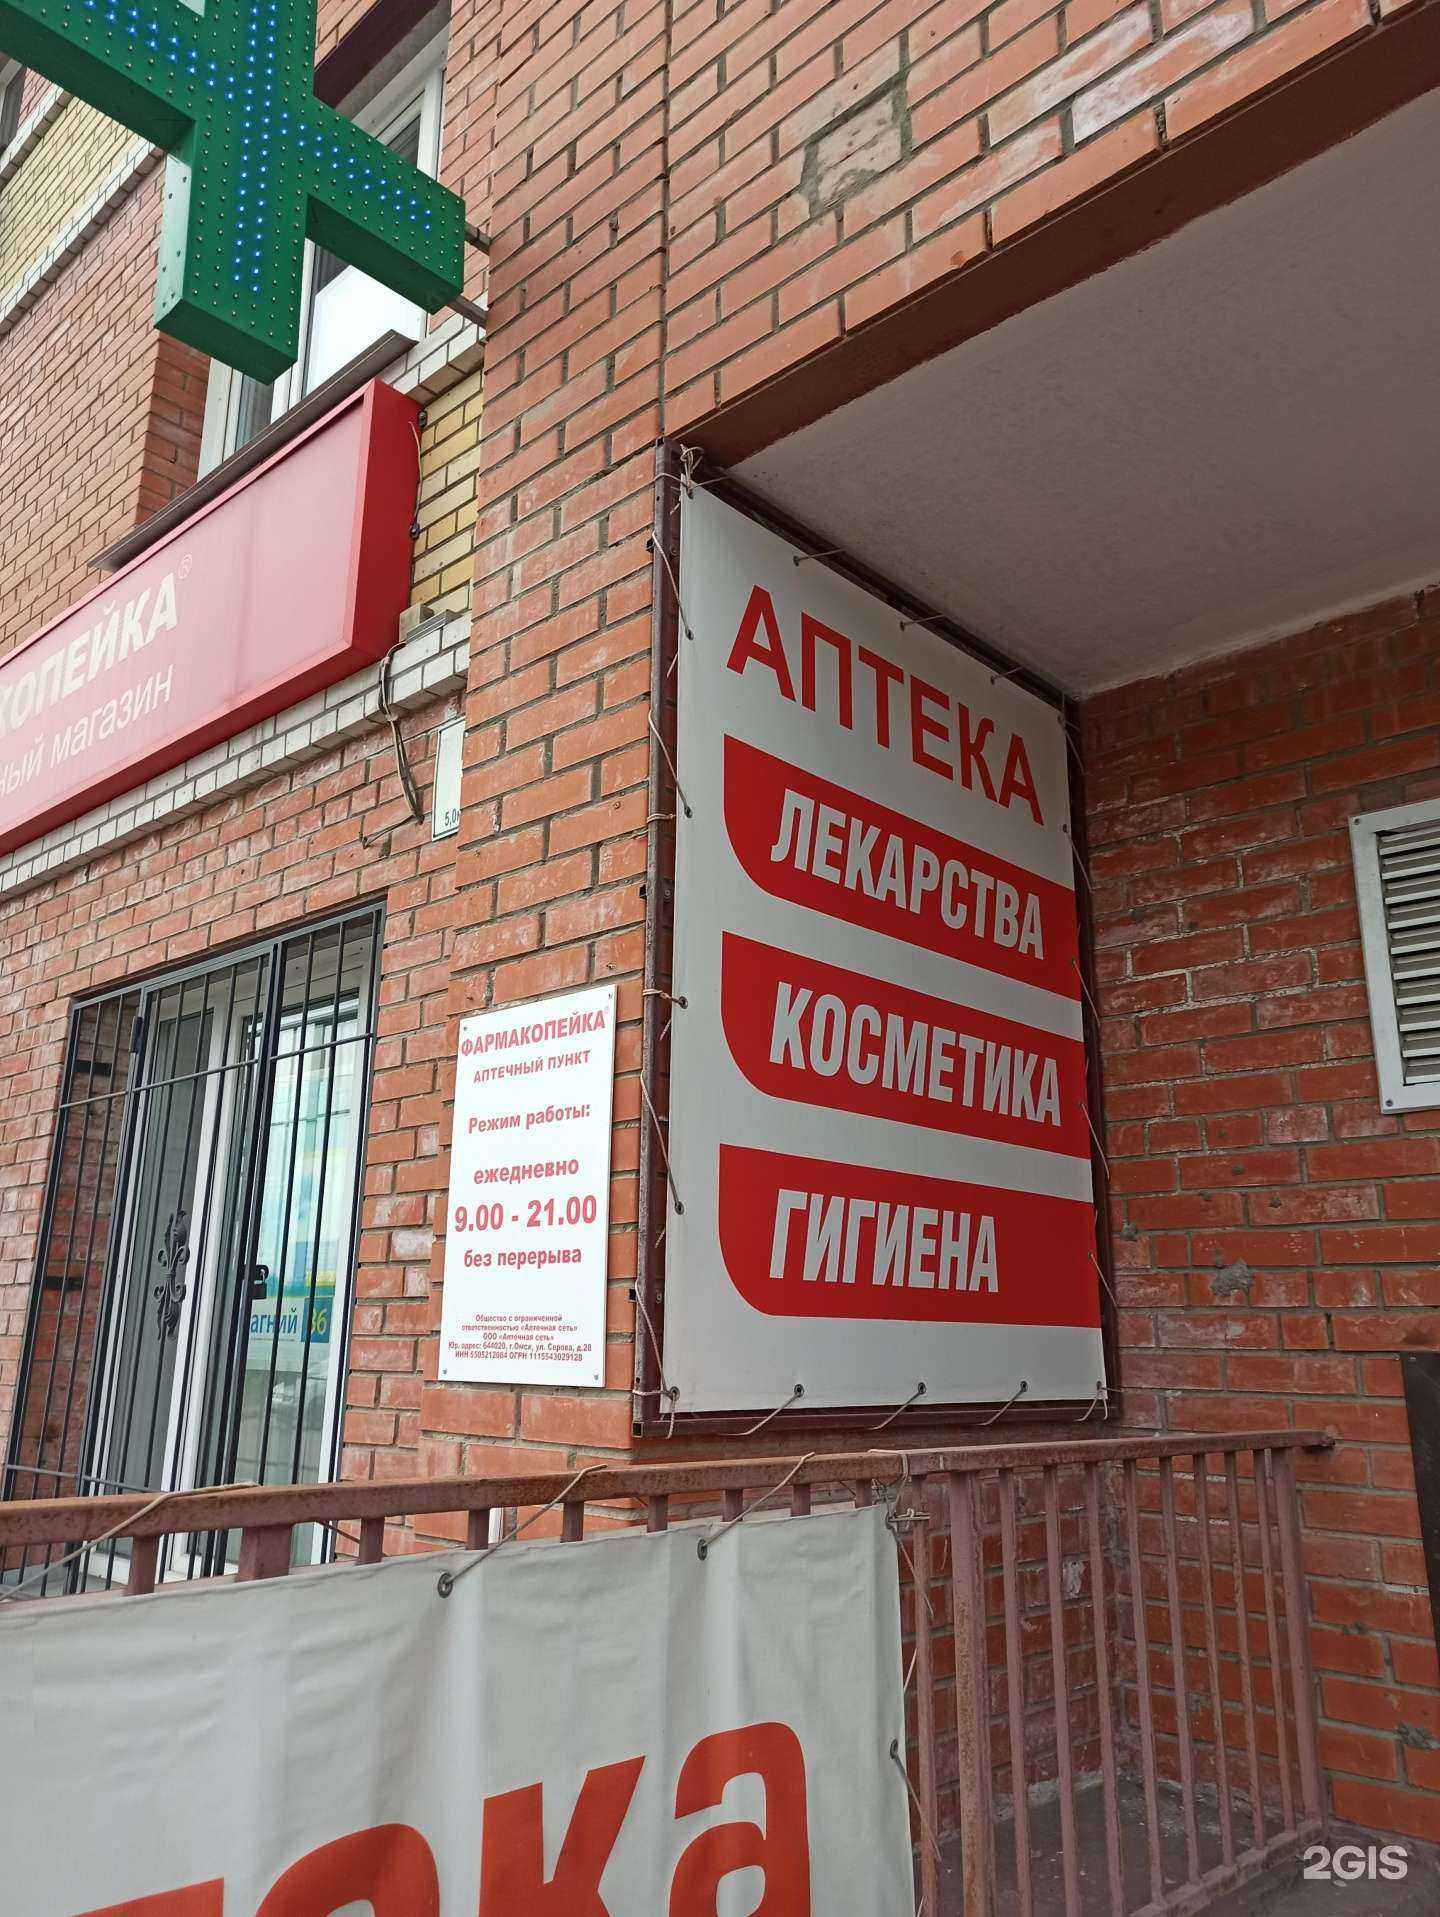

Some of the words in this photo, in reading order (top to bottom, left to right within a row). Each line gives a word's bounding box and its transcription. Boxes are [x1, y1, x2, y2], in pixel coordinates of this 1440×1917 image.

[50, 664, 174, 769] магазин
[726, 584, 1044, 826] АПТЕКА
[770, 788, 1044, 960] ЛЕКАРСТВА
[461, 1009, 606, 1057] ФАРМАКОПЕЙКА
[769, 981, 1062, 1127] КОСМЕТИКА
[473, 1056, 544, 1084] АПТЕЧНЫЙ
[547, 1049, 591, 1071] ПУНКТ
[468, 1114, 521, 1134] Режим
[525, 1103, 591, 1130] работы:
[473, 1159, 579, 1185] ежедневно
[454, 1202, 505, 1233] 9.00
[526, 1194, 597, 1228] 21.00
[464, 1249, 492, 1268] без
[497, 1248, 582, 1270] перерыва
[769, 1188, 999, 1293] ГИГИЕНА
